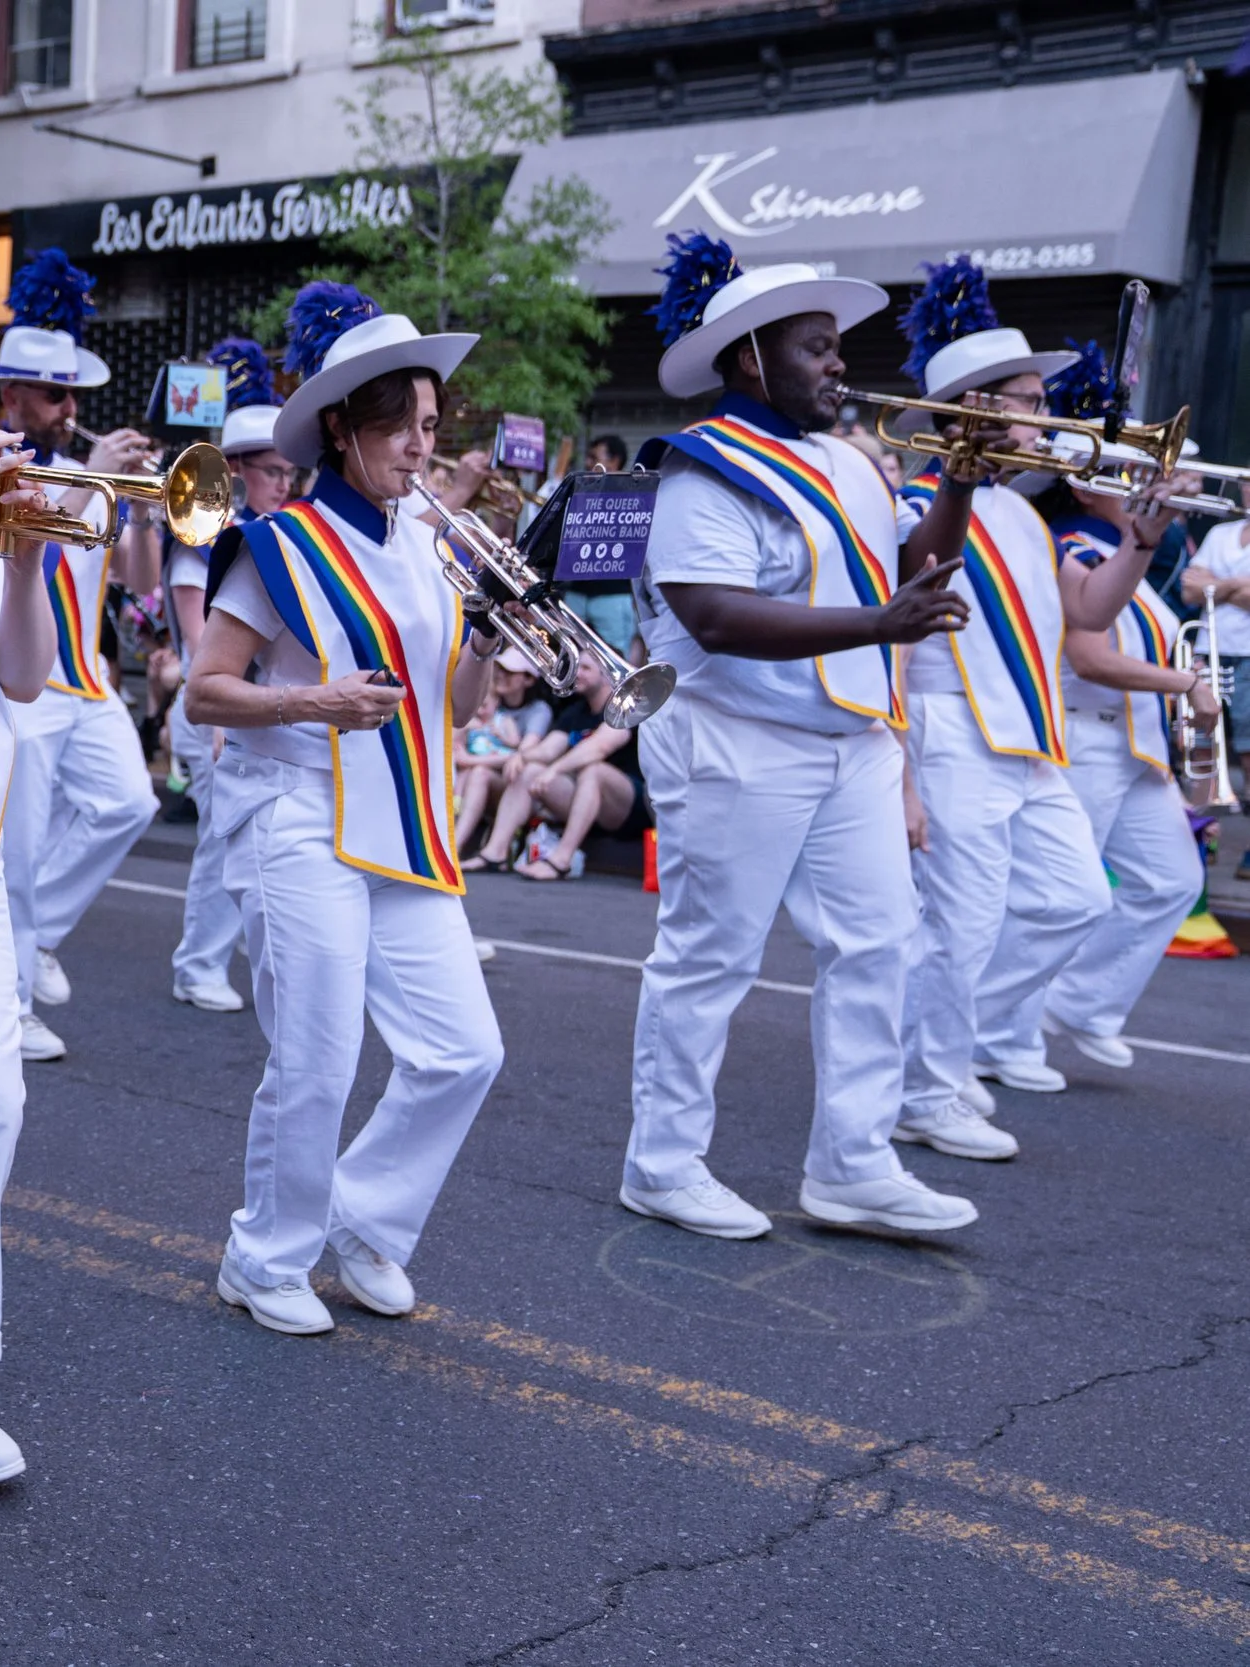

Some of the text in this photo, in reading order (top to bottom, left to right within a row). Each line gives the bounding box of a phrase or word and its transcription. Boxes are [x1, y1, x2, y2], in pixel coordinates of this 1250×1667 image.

[653, 146, 796, 237] K
[743, 183, 925, 224] Skincare
[92, 177, 413, 255] Les Enfants Terribles
[945, 243, 1096, 271] 58-622-0365
[585, 498, 640, 510] THE QUEER
[566, 511, 652, 525] BIG APPLE CORPS
[563, 526, 648, 539] MARCHING BAND
[572, 560, 626, 574] QBAC.ORG
